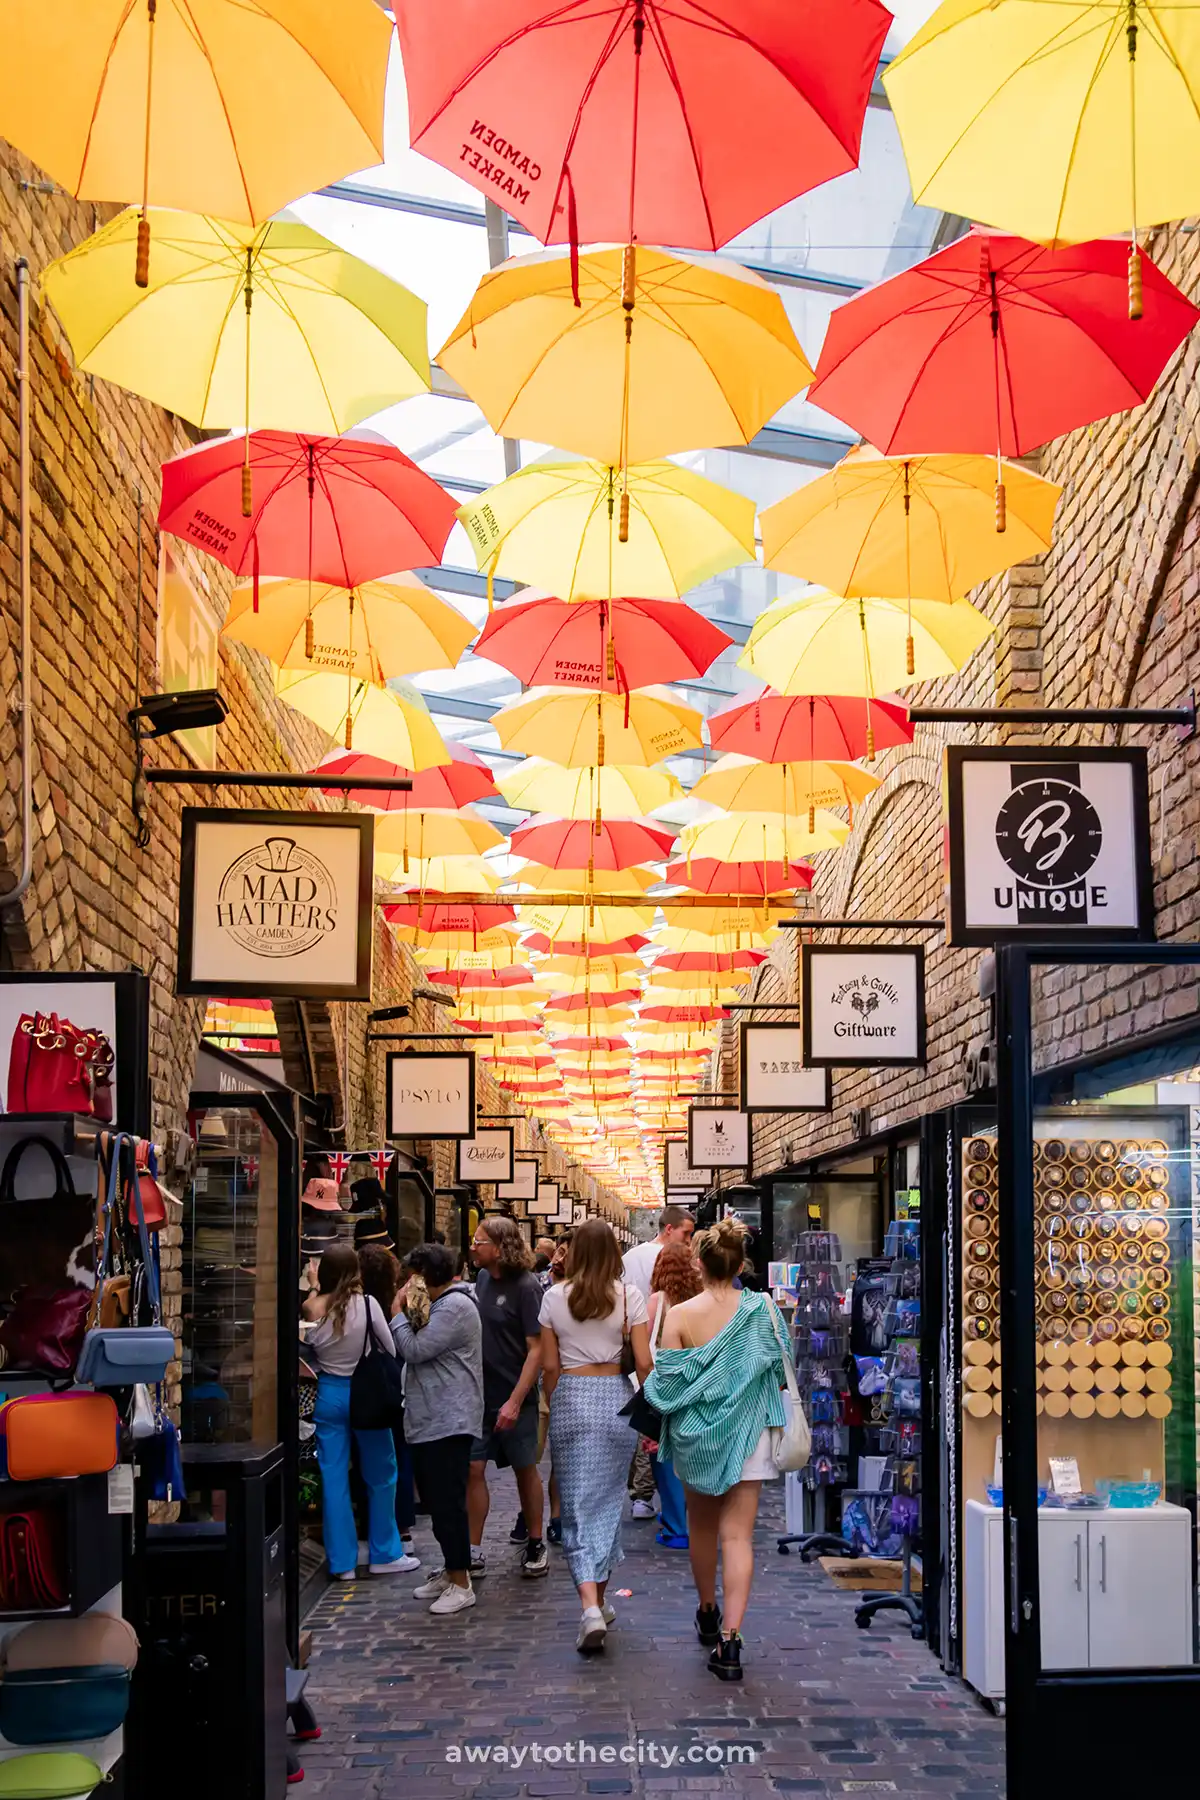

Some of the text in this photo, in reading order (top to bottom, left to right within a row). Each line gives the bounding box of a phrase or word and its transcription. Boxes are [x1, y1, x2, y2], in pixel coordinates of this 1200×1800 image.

[1017, 800, 1075, 871] B
[240, 874, 317, 902] MAD
[994, 886, 1108, 911] UNIQUE
[216, 902, 338, 932] HATTERS
[255, 927, 294, 939] CAMDEN
[834, 1021, 897, 1037] Giftware
[400, 1089, 461, 1104] PSYLO
